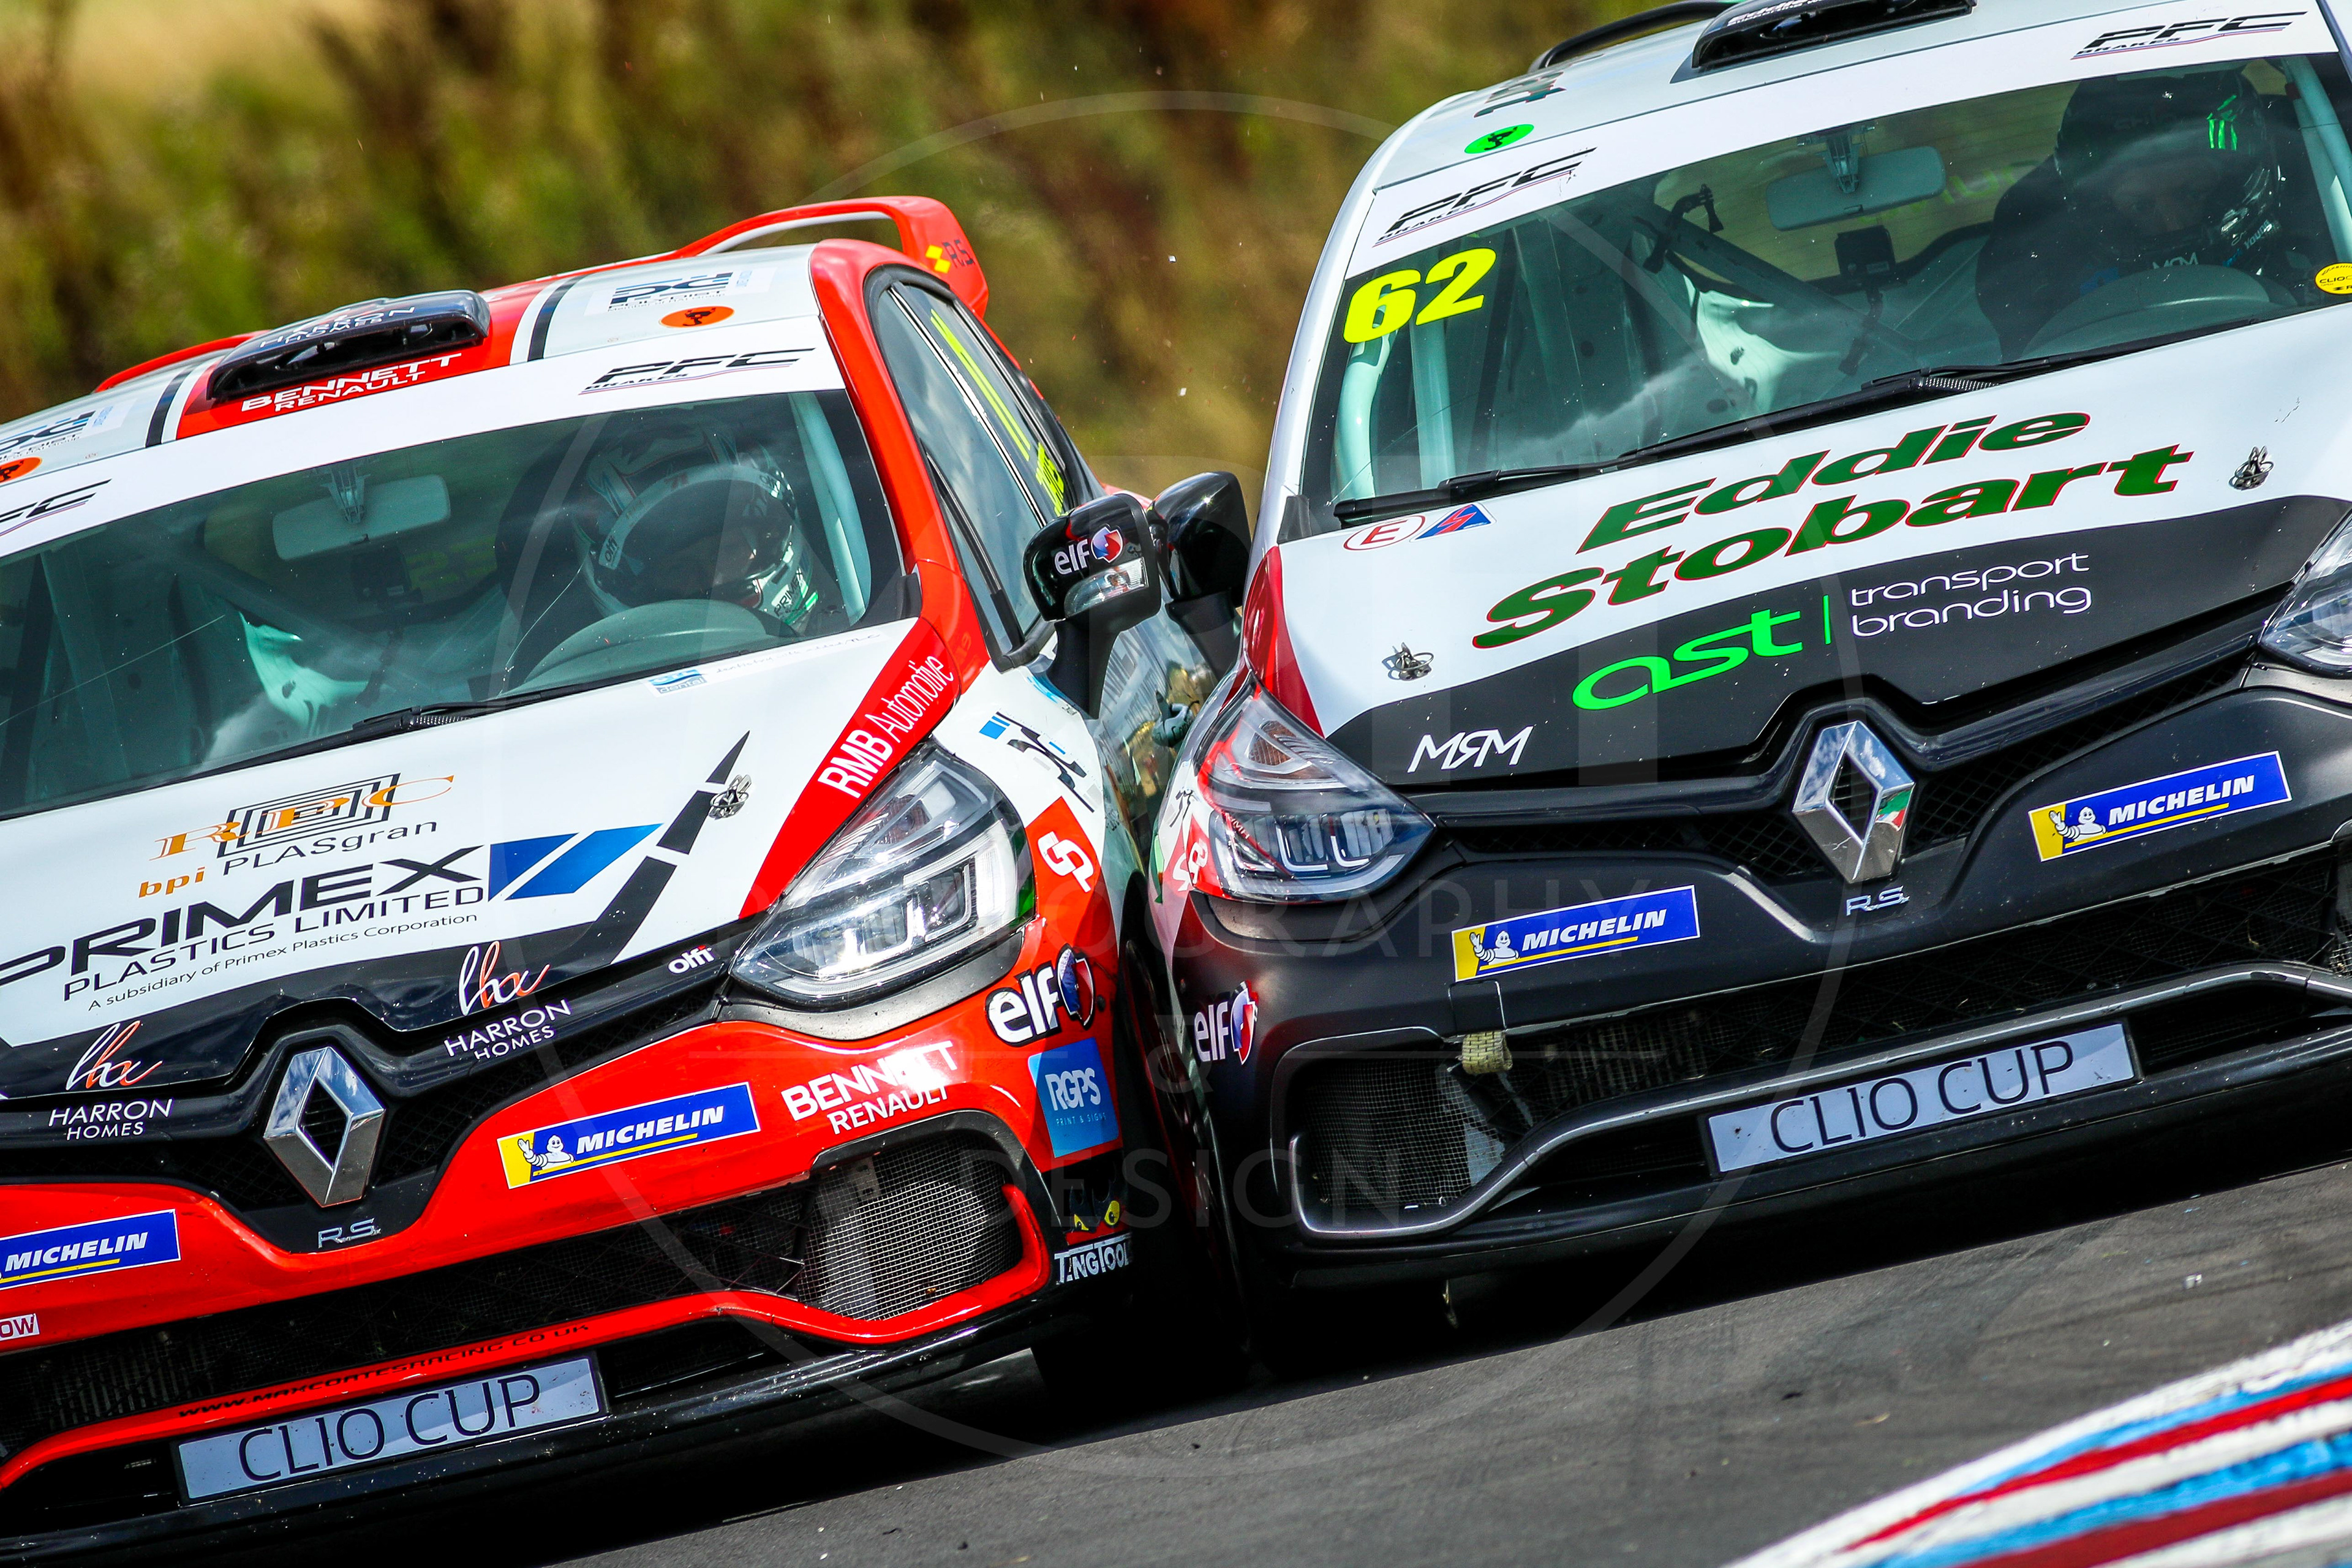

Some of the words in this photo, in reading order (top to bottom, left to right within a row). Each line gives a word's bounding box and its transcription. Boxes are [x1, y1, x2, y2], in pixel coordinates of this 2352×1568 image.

[2090, 12, 2307, 48] PFC
[1385, 147, 1597, 233] PFC
[1343, 247, 1497, 344] 62
[241, 353, 461, 412] BENNETT
[275, 371, 425, 412] RENAULT
[593, 348, 815, 384] PFC
[1576, 412, 2090, 554] Eddie
[1054, 540, 1090, 575] elf
[1472, 443, 2194, 649] Stobart
[1851, 552, 2090, 607] transport
[1851, 586, 2092, 638] branding
[660, 678, 705, 693] dental
[1573, 609, 1803, 710] ast
[818, 728, 894, 798] RMB
[865, 655, 954, 744] Automotive
[149, 775, 454, 861] RPC
[2108, 774, 2255, 825] MICHELIN
[223, 821, 437, 876] PLASgran
[138, 867, 205, 899] bpi
[0, 845, 484, 981] PRIMEX
[1521, 908, 1666, 951] MICHELIN
[64, 923, 274, 1001] PLASTICS
[296, 885, 484, 934] LIMITED
[88, 998, 101, 1011] A
[107, 969, 196, 1007] subsidiary
[202, 962, 221, 976] of
[226, 947, 287, 970] Primex
[293, 930, 359, 953] Plastics
[364, 913, 477, 938] Corporation
[444, 1000, 571, 1057] HARRON
[989, 965, 1060, 1043] elf
[474, 1025, 554, 1060] HOMES
[1195, 1001, 1231, 1063] elf
[48, 1099, 173, 1127] HARRON
[827, 1085, 949, 1135] RENAULT
[1045, 1068, 1101, 1111] RGPS
[1771, 1077, 1918, 1154] CLIO
[1937, 1041, 2073, 1115] CUP
[67, 1121, 145, 1140] HOMES
[576, 1106, 724, 1155] MICHELIN
[1057, 1115, 1076, 1126] PRINT
[5, 1231, 148, 1272] MICHELIN
[238, 1408, 386, 1482] CLIO
[404, 1373, 541, 1445] CUP
